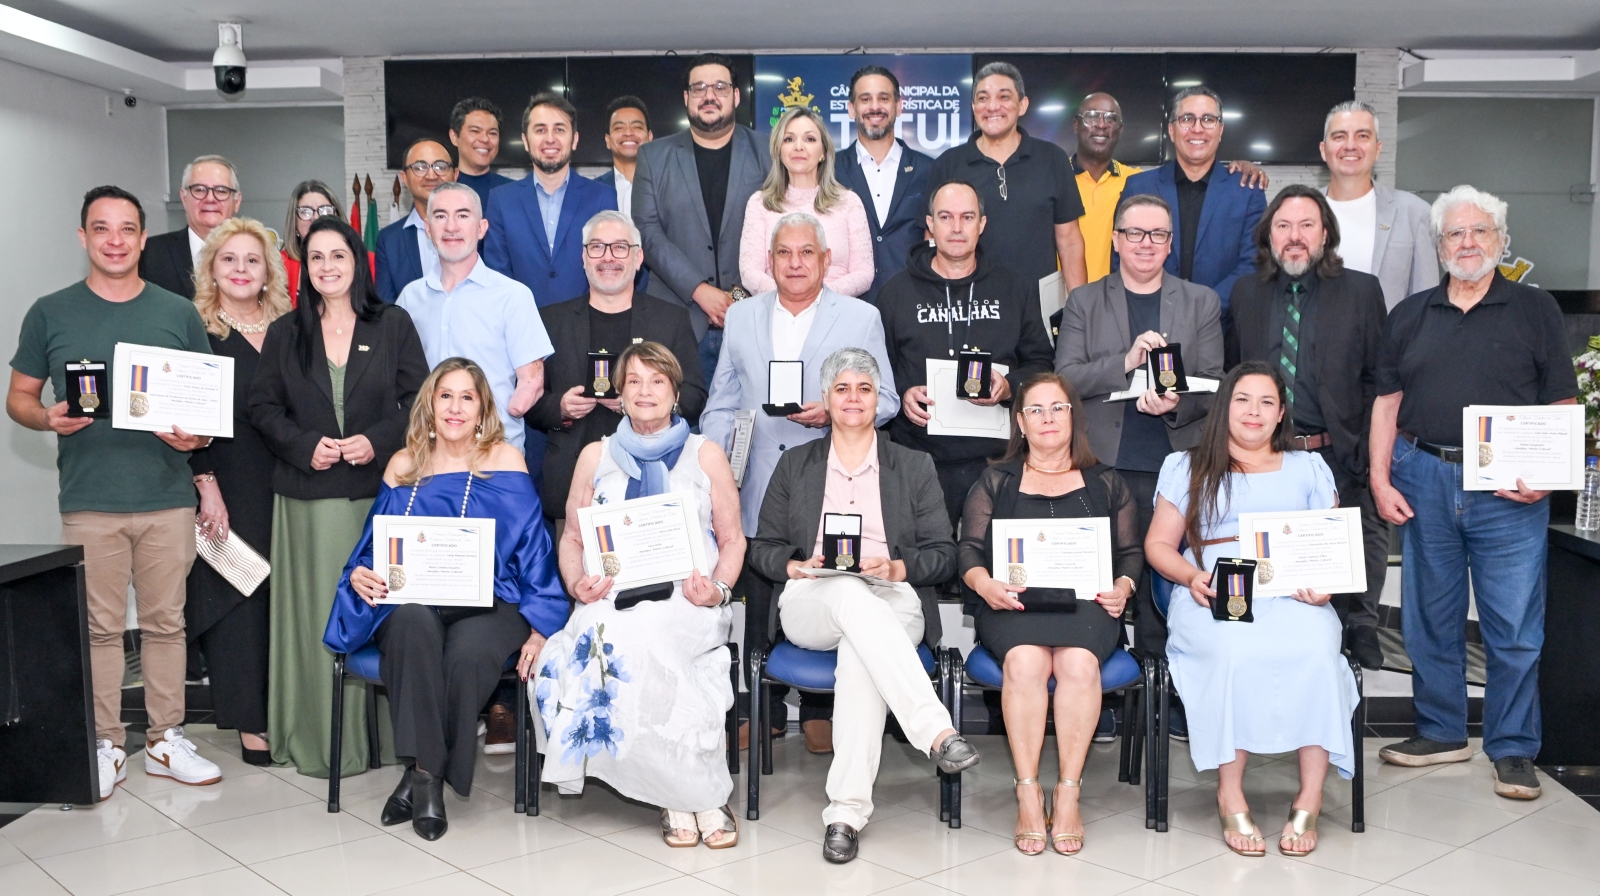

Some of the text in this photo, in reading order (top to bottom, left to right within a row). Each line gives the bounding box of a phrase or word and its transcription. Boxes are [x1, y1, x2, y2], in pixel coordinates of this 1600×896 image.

[899, 86, 960, 96] NICIPAL DA
[901, 97, 960, 110] RÍSTICA DE
[830, 108, 960, 150] TTUÍ
[916, 299, 962, 309] CLUE
[917, 304, 1001, 323] CANALHAS
